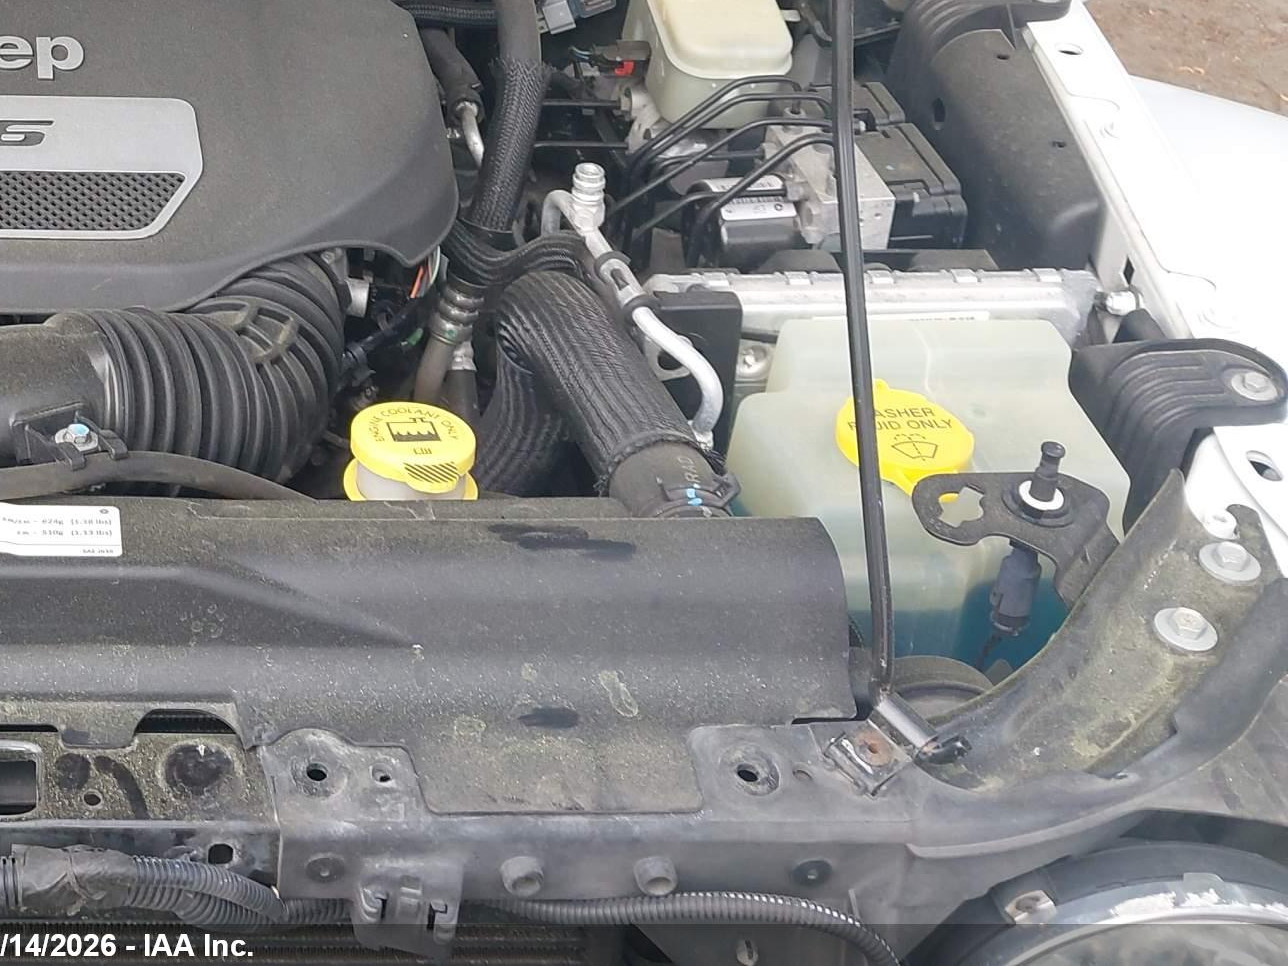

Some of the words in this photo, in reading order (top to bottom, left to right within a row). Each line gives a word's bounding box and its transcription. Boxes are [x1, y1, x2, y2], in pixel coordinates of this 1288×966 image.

[874, 407, 936, 418] ASHER
[380, 407, 440, 419] COOLANT
[441, 419, 459, 440] ONLY
[906, 419, 954, 430] ONLY
